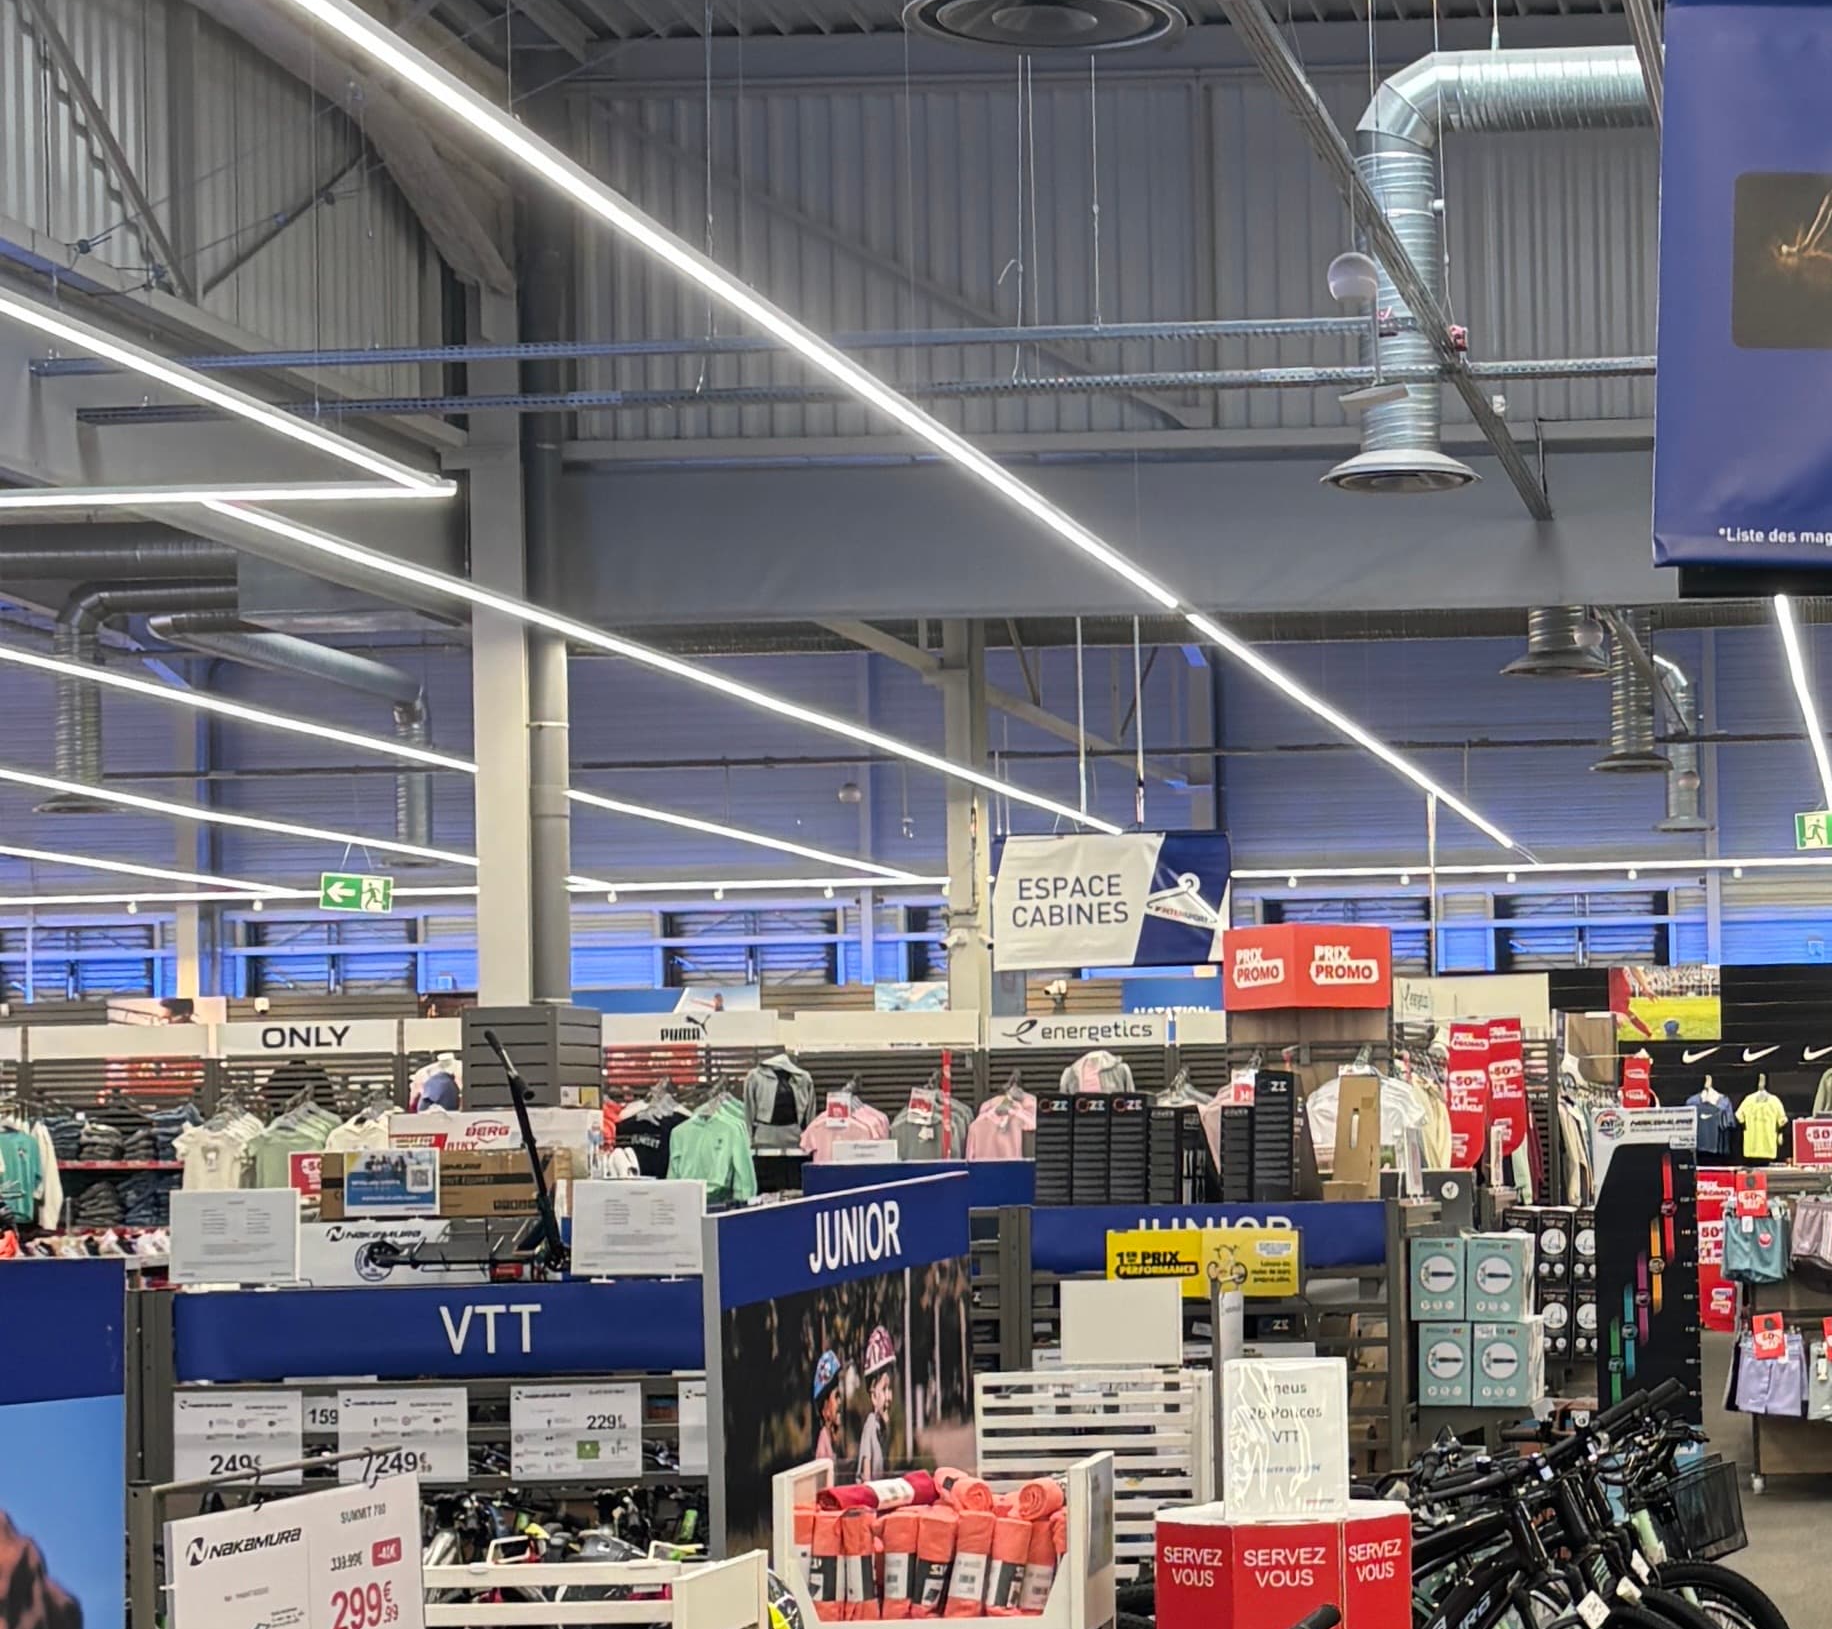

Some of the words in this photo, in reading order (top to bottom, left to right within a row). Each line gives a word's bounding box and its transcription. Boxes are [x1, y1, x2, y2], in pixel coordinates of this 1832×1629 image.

[1768, 528, 1797, 544] des
[1018, 873, 1123, 901] ESPACE
[1012, 901, 1129, 928] CABINES
[1236, 947, 1263, 964] PRIX
[1314, 945, 1351, 961] PRIX
[1237, 965, 1280, 983] PROMO
[1315, 964, 1373, 980] PROMO
[262, 1025, 351, 1049] ONLY
[660, 1027, 701, 1041] PUMA
[1041, 1022, 1153, 1042] energetics
[465, 1125, 511, 1137] BERG
[808, 1200, 902, 1274] JUNIOR
[1141, 1250, 1181, 1267] PRIX
[1118, 1264, 1197, 1276] PERFORMANCE
[438, 1303, 542, 1355] VTT
[1272, 1429, 1299, 1444] VTT
[1163, 1546, 1224, 1567] SERVEZ
[1243, 1546, 1326, 1567] SERVEZ
[1348, 1537, 1403, 1563] SERVEZ
[1171, 1568, 1215, 1588] VOUS
[1255, 1569, 1315, 1588] VOUS
[1355, 1560, 1395, 1583] VOUS
